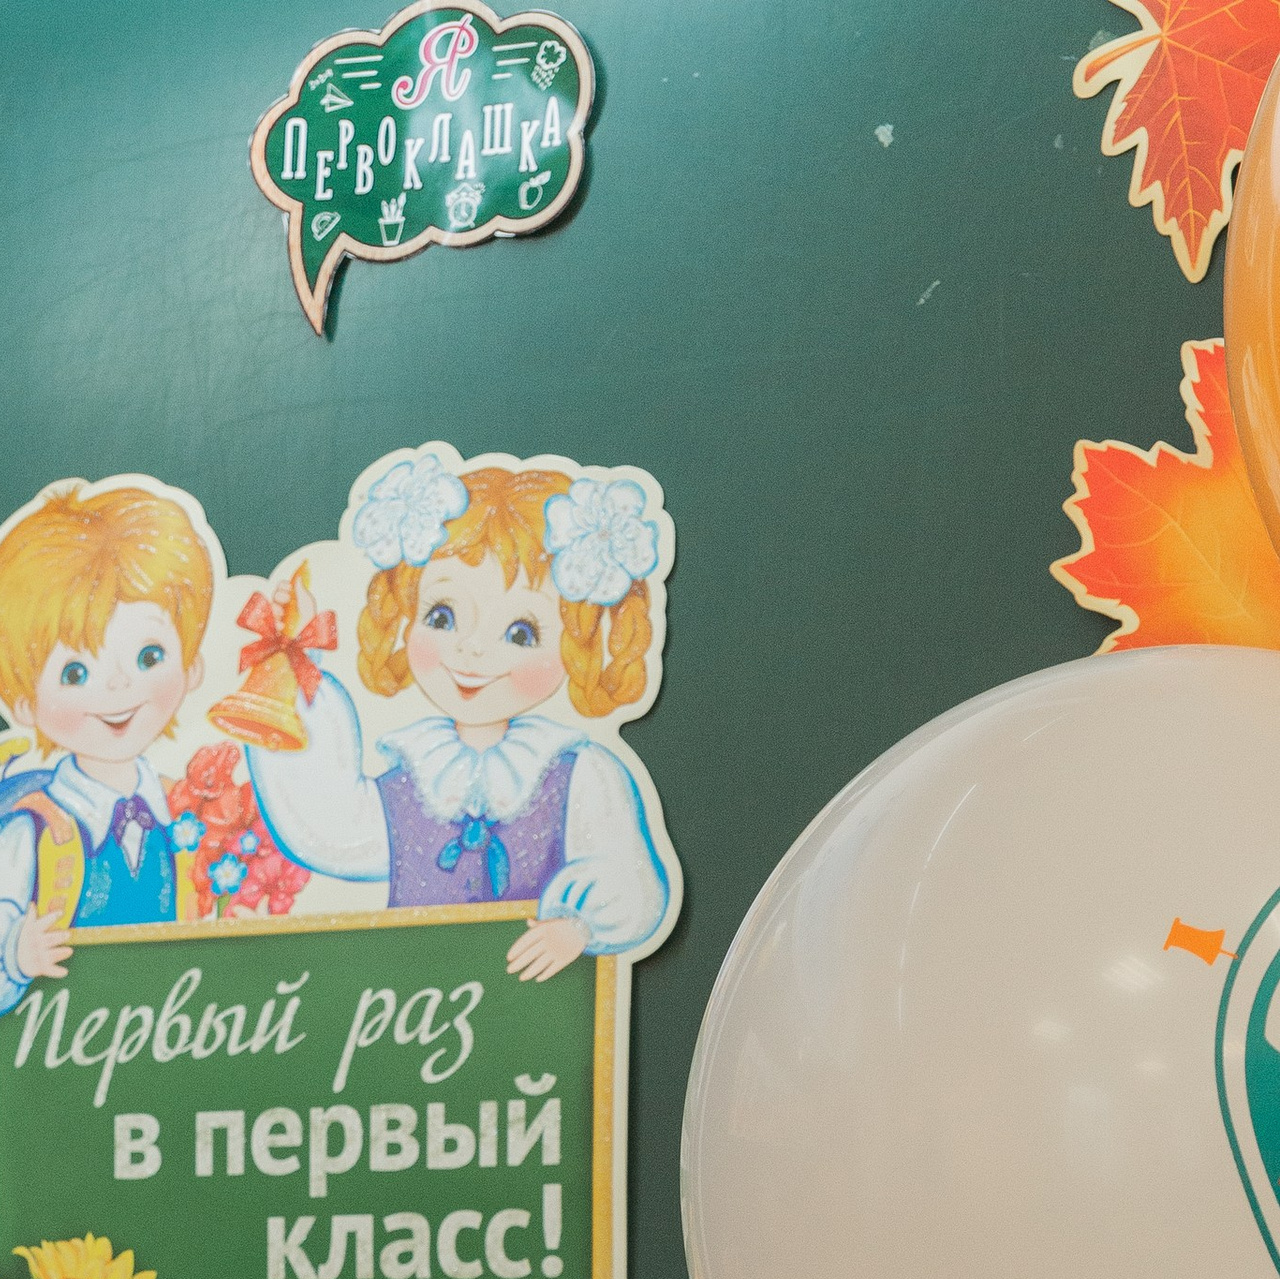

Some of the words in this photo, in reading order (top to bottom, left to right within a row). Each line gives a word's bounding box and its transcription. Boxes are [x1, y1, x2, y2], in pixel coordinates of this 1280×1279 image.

[392, 14, 479, 109] Я
[14, 968, 310, 1108] Первый
[332, 980, 484, 1093] раз
[114, 1111, 163, 1180] в
[194, 1073, 562, 1198] первый
